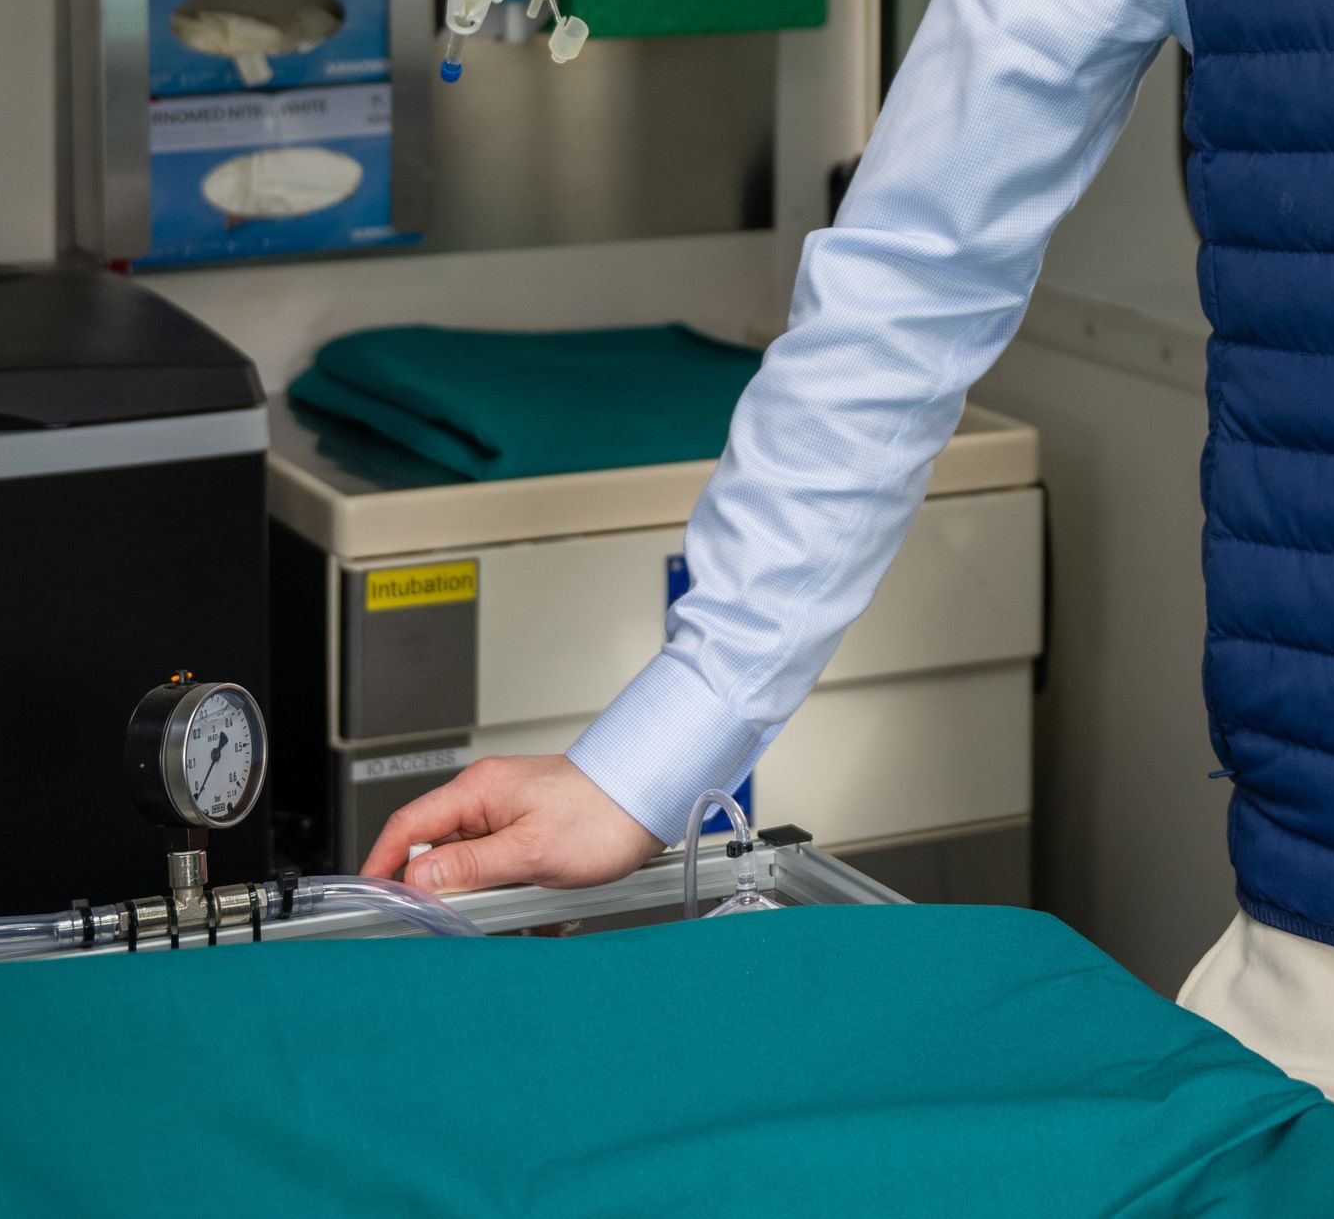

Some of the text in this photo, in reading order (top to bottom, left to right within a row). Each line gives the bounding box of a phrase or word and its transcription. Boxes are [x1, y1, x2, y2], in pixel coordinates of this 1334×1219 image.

[151, 105, 225, 124] RNOMED
[282, 98, 327, 115] WHITE
[372, 575, 474, 599] Intubation
[193, 728, 201, 739] 0.2
[235, 742, 243, 753] 0.5
[389, 749, 457, 771] ACCESS
[229, 771, 237, 783] 0.6
